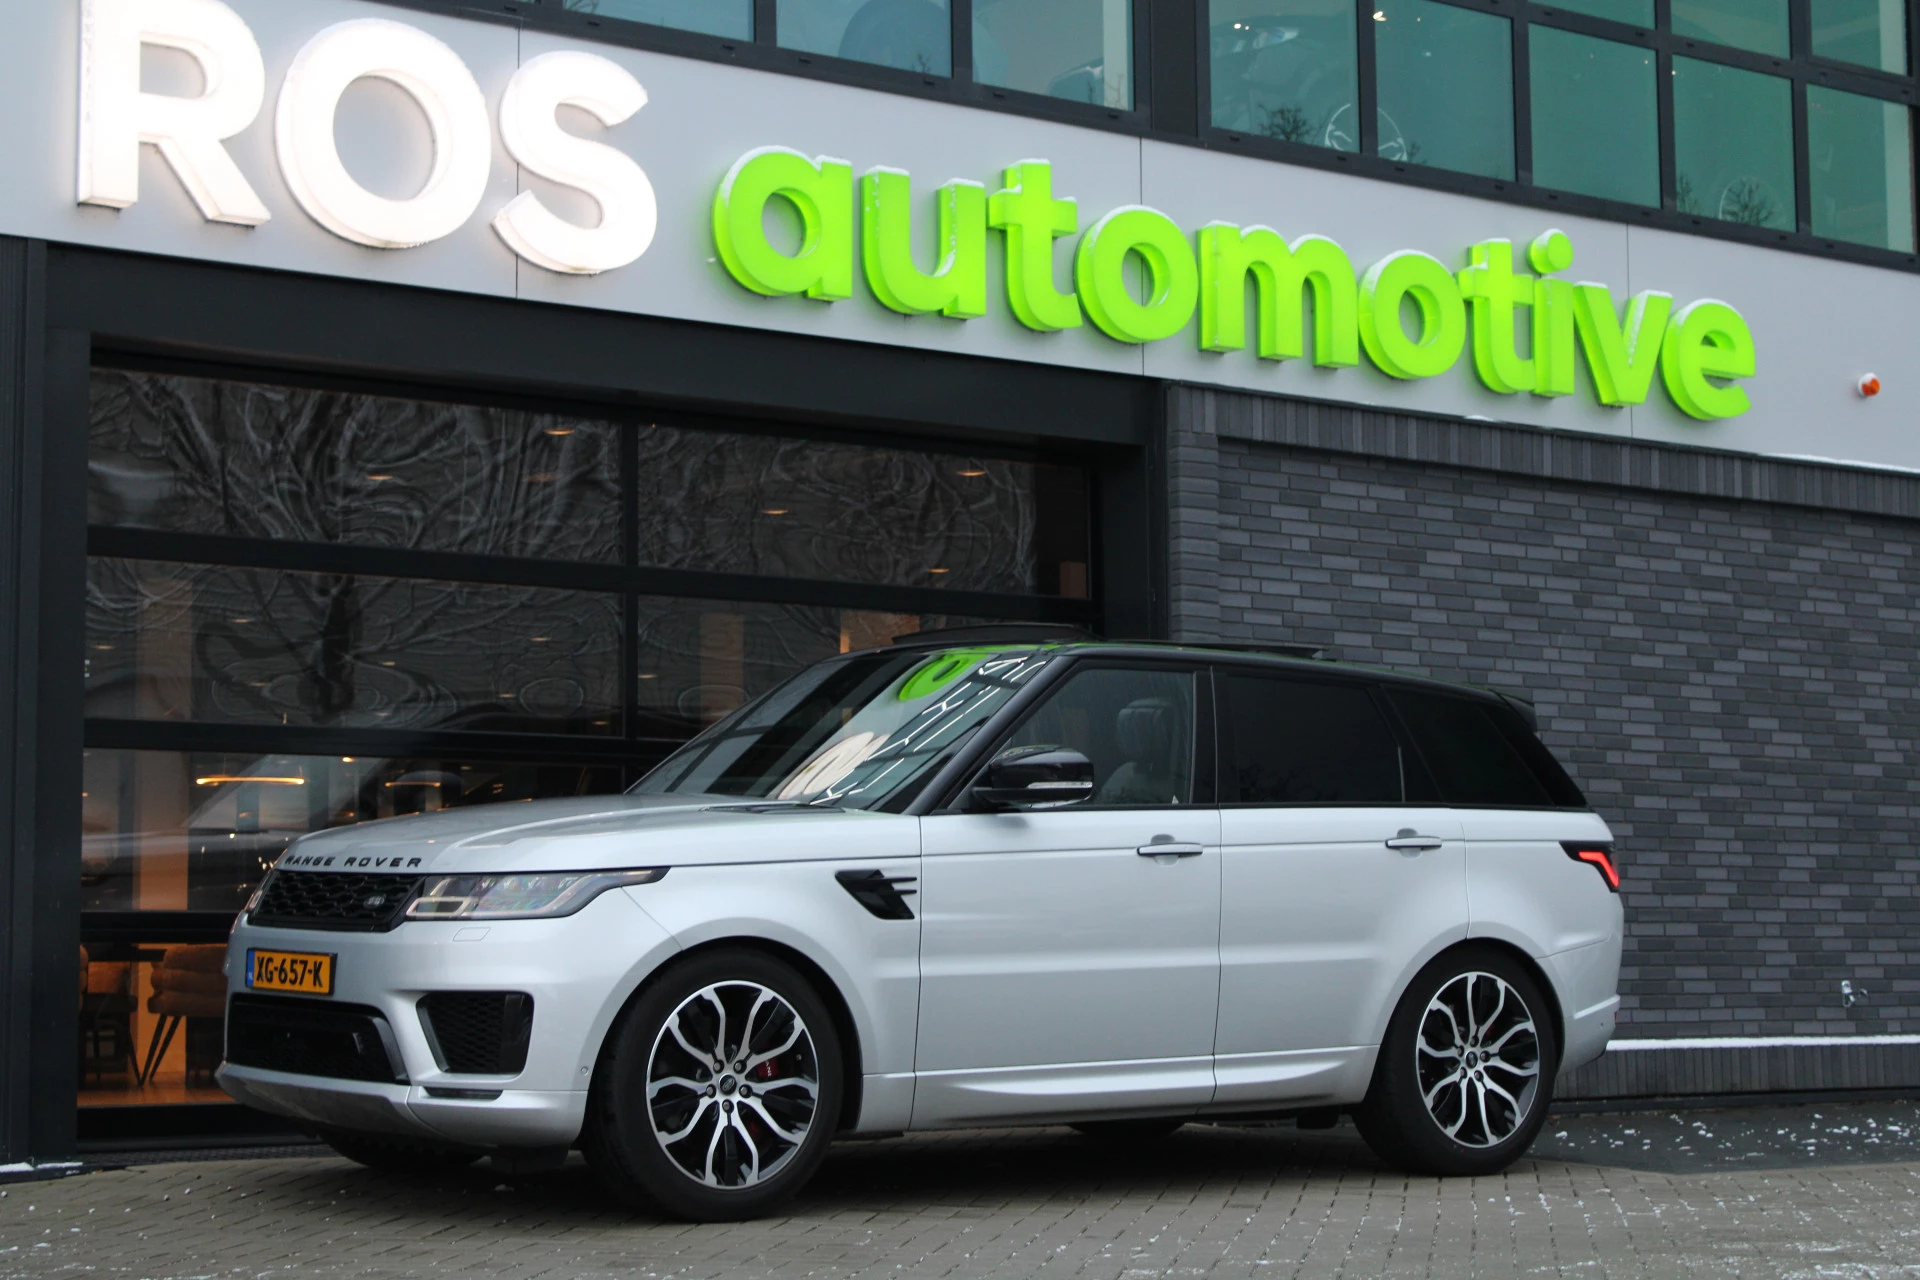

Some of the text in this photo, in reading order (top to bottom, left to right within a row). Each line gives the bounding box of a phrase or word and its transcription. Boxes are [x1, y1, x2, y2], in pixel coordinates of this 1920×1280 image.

[77, 0, 1756, 420] ROS automotive
[284, 855, 422, 868] RANGE ROVER
[256, 956, 323, 988] XG-657-K
